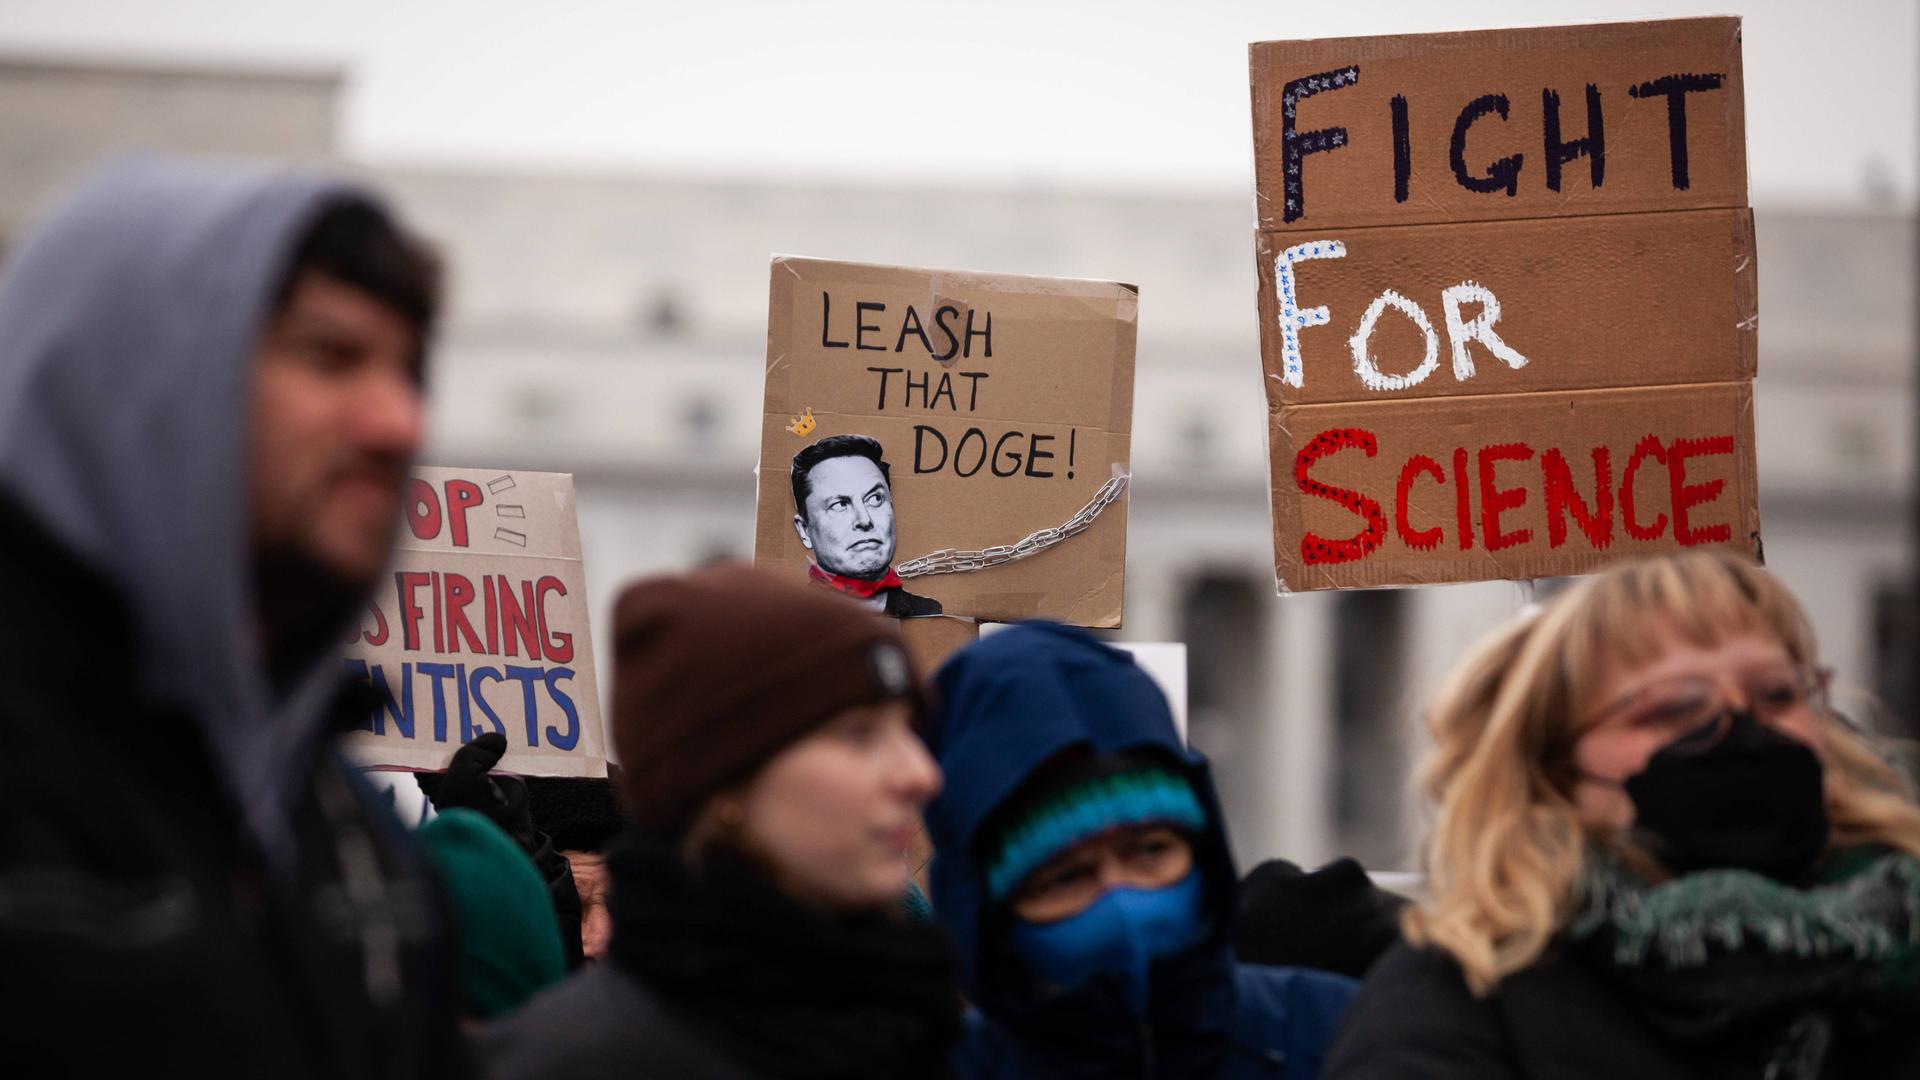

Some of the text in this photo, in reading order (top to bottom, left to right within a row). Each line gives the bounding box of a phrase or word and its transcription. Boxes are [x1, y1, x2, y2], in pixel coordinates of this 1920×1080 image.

[1282, 65, 1728, 223] FIGHT
[822, 290, 993, 362] LEASH
[1274, 239, 1529, 391] FOR
[867, 366, 990, 412] THAT
[912, 424, 1077, 480] DOGE!
[404, 478, 485, 548] OP
[1292, 427, 1735, 566] SCIENCE
[395, 570, 575, 664] FIRING
